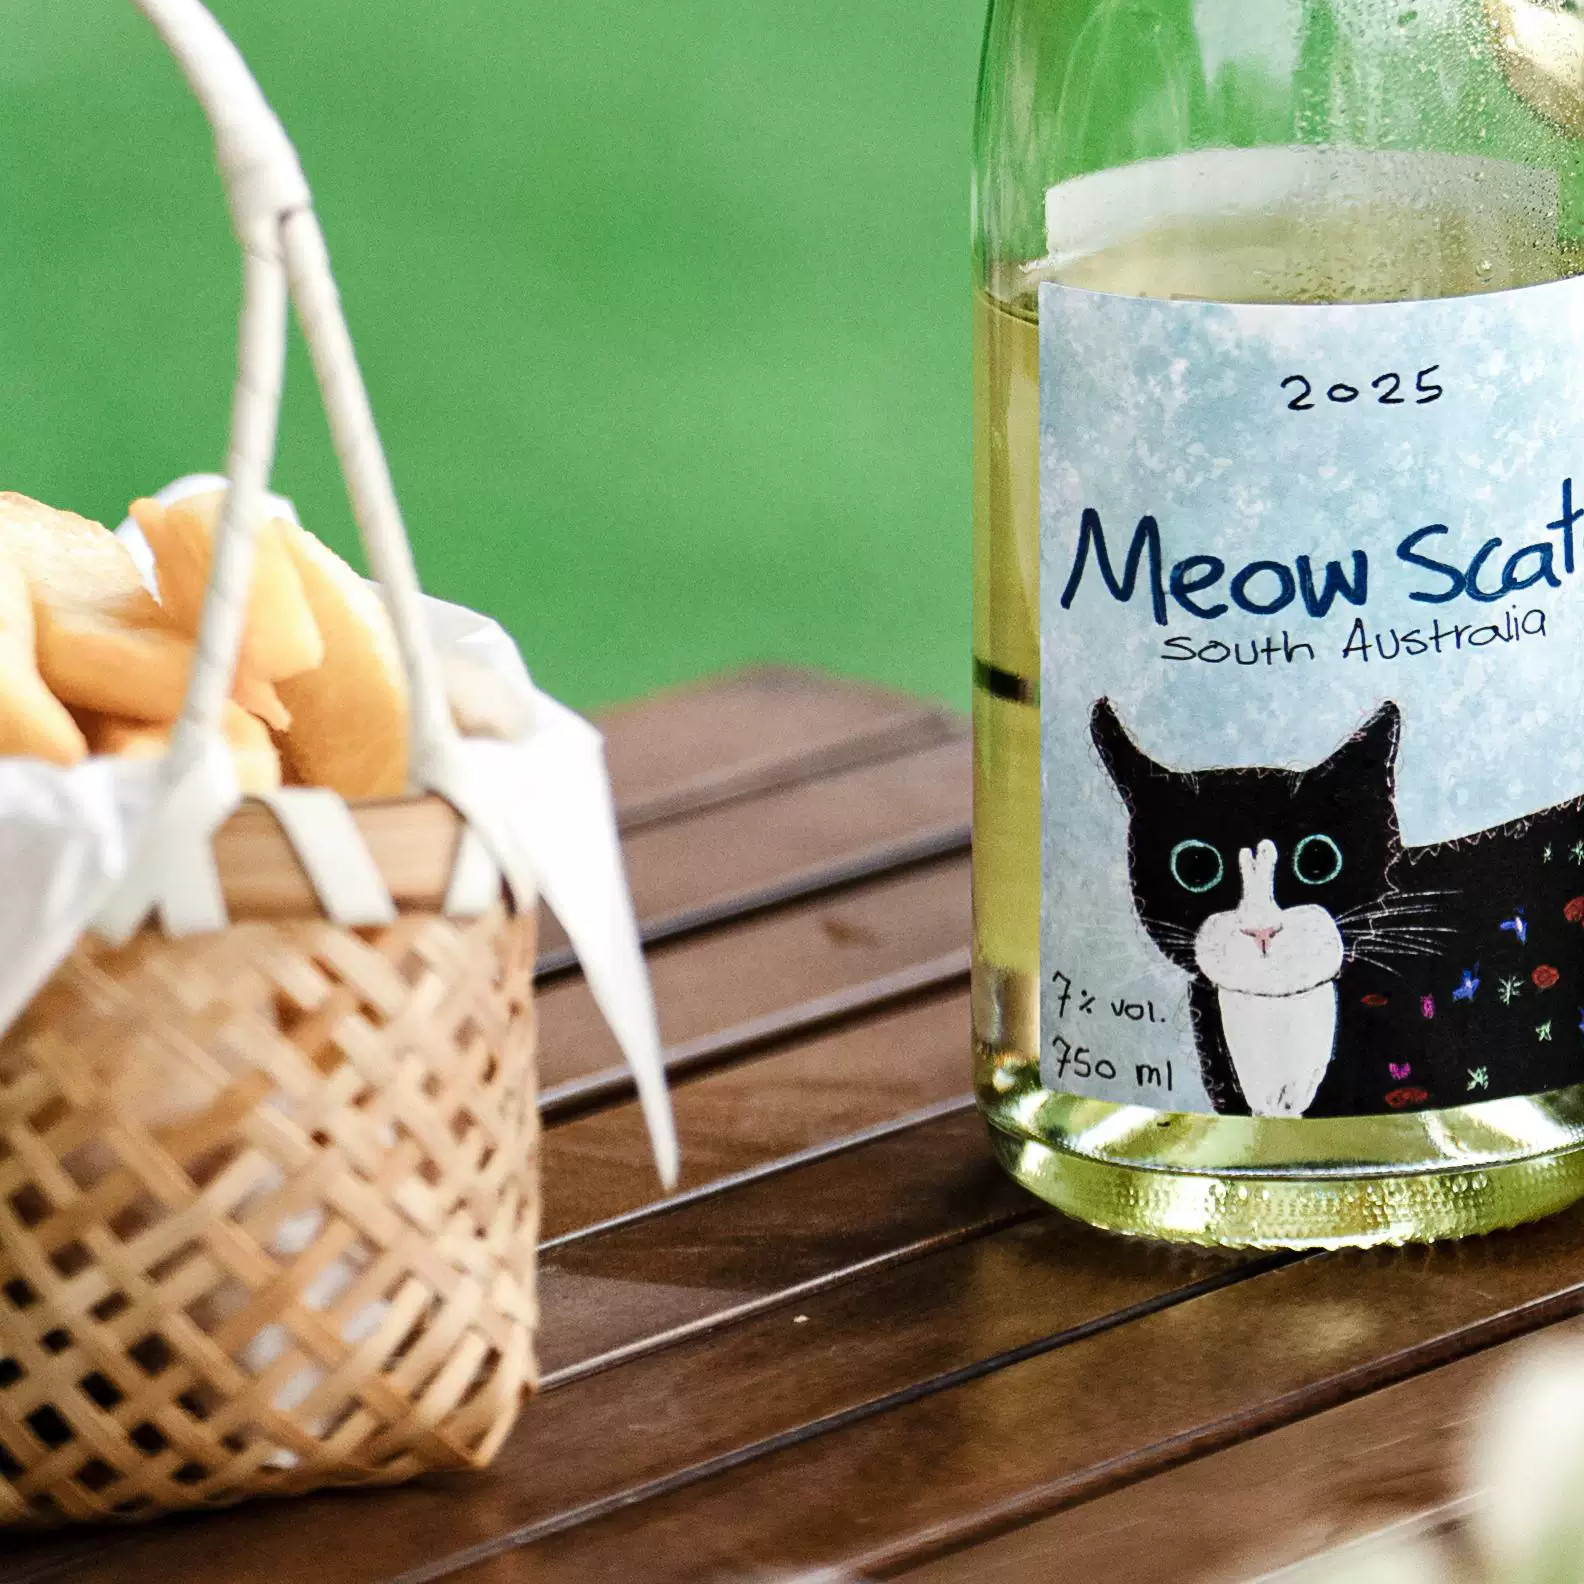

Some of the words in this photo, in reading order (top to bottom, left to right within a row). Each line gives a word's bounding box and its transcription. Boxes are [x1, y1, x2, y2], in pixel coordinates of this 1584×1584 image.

[1280, 365, 1444, 411] 2025
[1060, 507, 1369, 626] Meow
[1342, 605, 1547, 663] Australia
[1052, 970, 1096, 1018] 7%
[1110, 999, 1166, 1023] vol.
[1052, 1035, 1117, 1079] 750
[1135, 1060, 1173, 1092] ml
